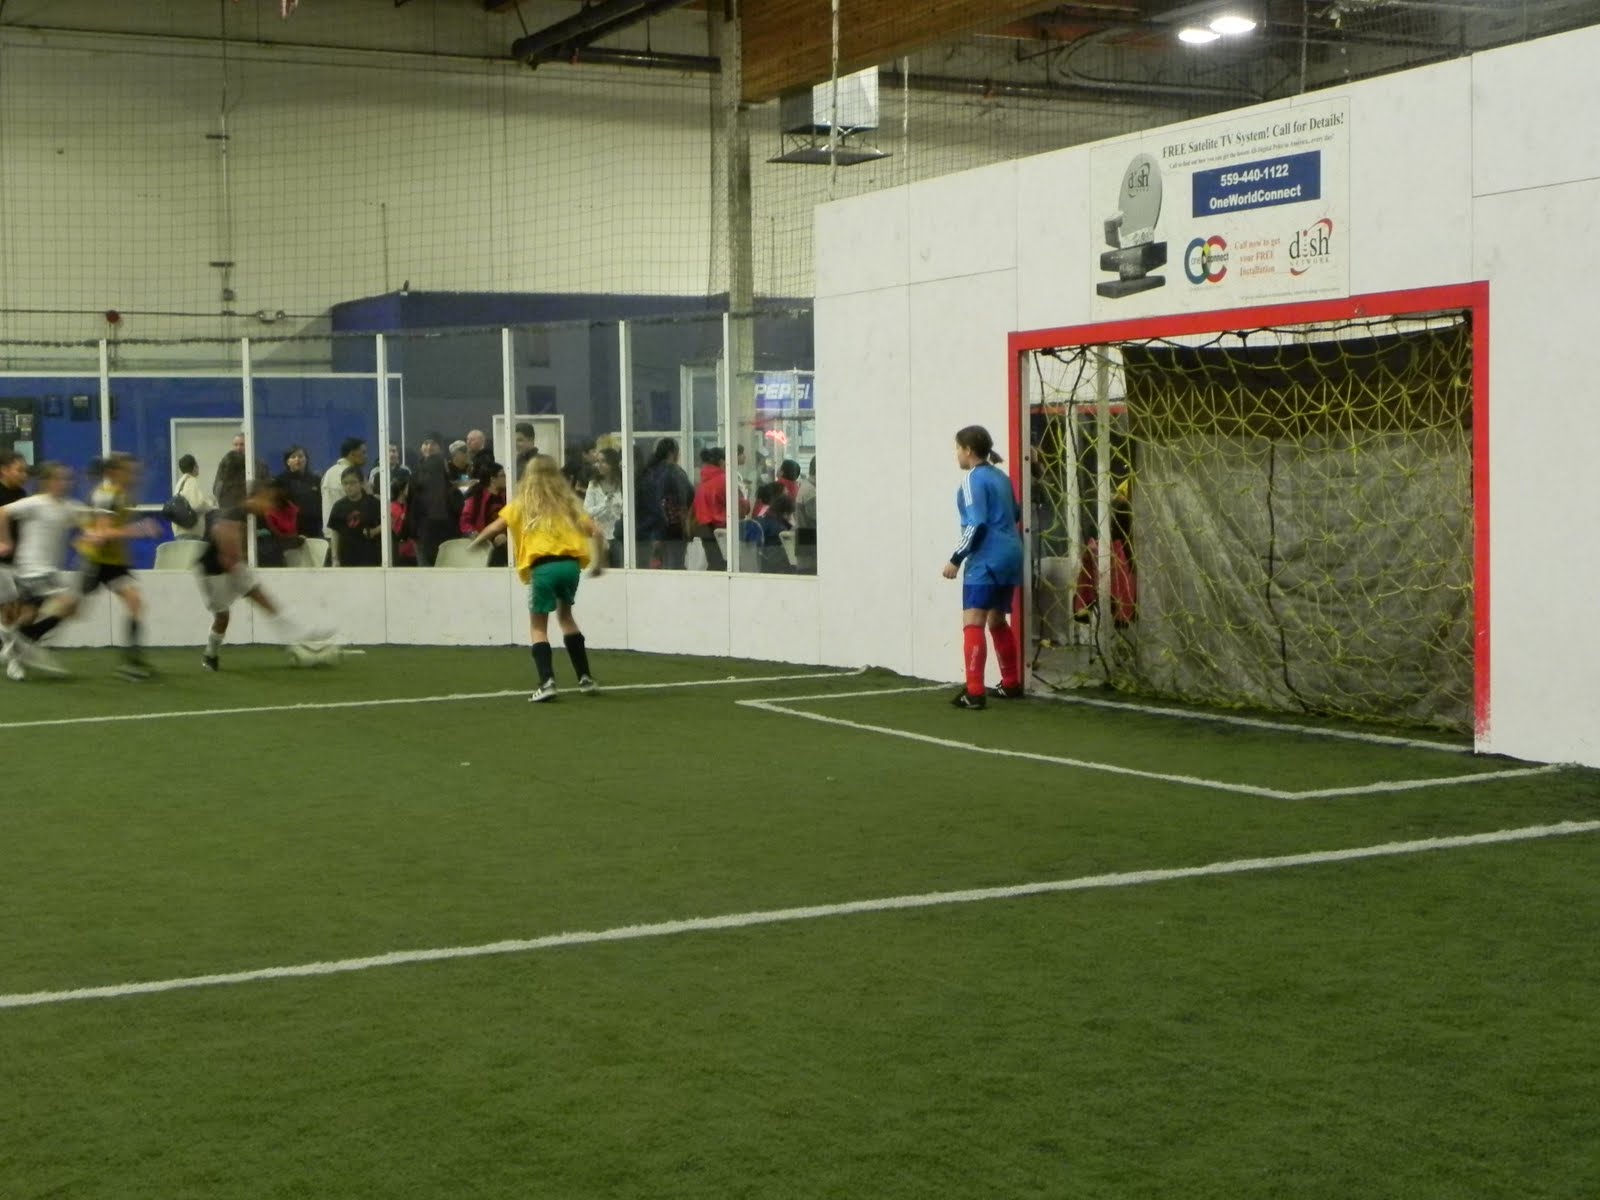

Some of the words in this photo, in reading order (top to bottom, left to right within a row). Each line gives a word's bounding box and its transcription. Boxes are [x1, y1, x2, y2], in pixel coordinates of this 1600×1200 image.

[1162, 146, 1186, 159] FREE
[1188, 137, 1218, 155] Satelite
[1220, 134, 1235, 148] TV
[1236, 126, 1270, 147] System!
[1272, 122, 1292, 138] Call
[1293, 120, 1307, 134] for
[1308, 111, 1344, 131] Details!
[1220, 164, 1290, 187] 559-440-1122
[1209, 184, 1302, 210] OneWorldConnect
[1289, 228, 1330, 260] dish
[754, 383, 810, 400] PEPSI
